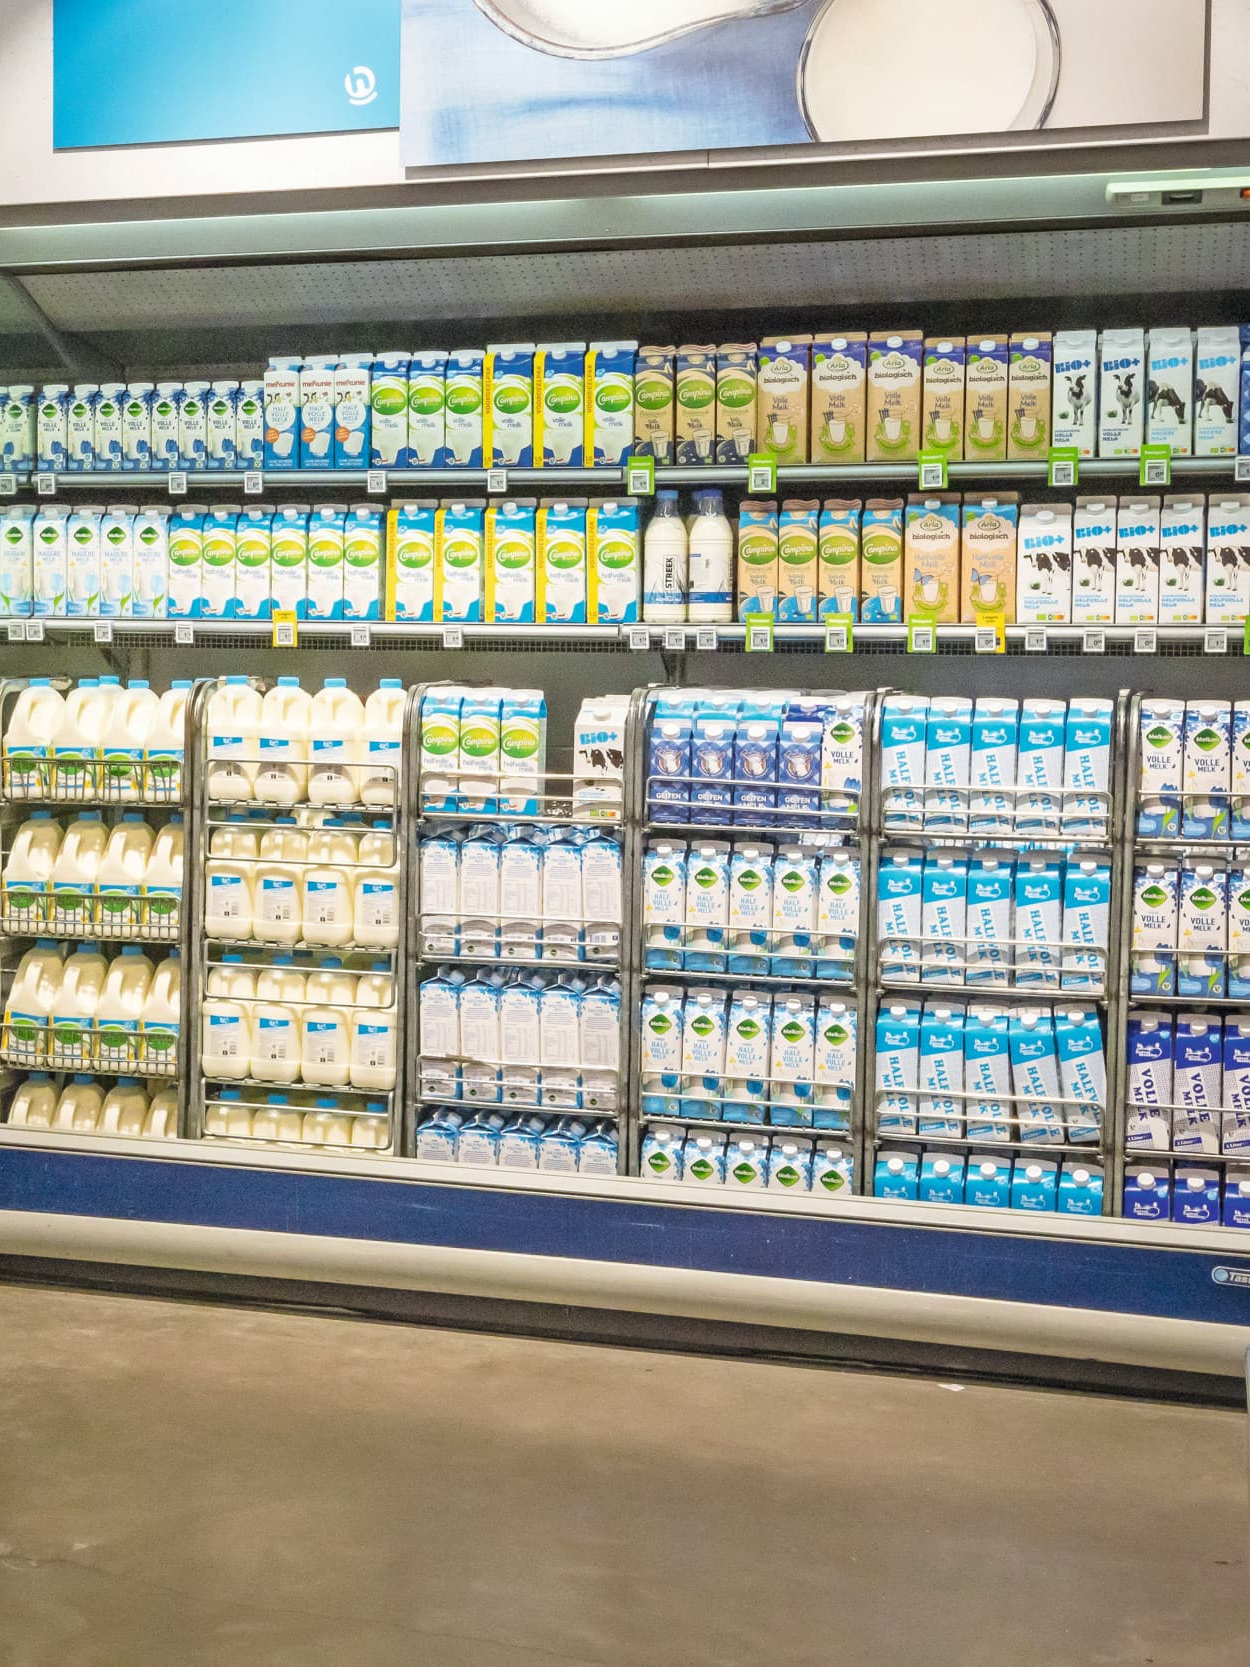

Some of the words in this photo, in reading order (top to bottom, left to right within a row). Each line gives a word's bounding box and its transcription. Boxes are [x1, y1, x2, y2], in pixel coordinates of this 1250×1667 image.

[764, 374, 799, 386] biologisch
[819, 372, 856, 383] biologisch
[874, 369, 912, 381] biologisch
[926, 374, 961, 385] biologisch
[1011, 372, 1048, 382] biologisch
[912, 530, 950, 542] biologisch
[969, 530, 1009, 542] biologisch
[742, 544, 775, 557] Campina
[781, 544, 814, 557] Campina
[821, 544, 855, 557] Campina
[864, 543, 898, 557] Campina
[665, 557, 673, 589] STREEK
[423, 734, 455, 747] Campina
[463, 735, 495, 749] Campina
[503, 737, 535, 750] Campina
[1194, 758, 1220, 766] VOLLE
[1141, 915, 1166, 923] VOLLE
